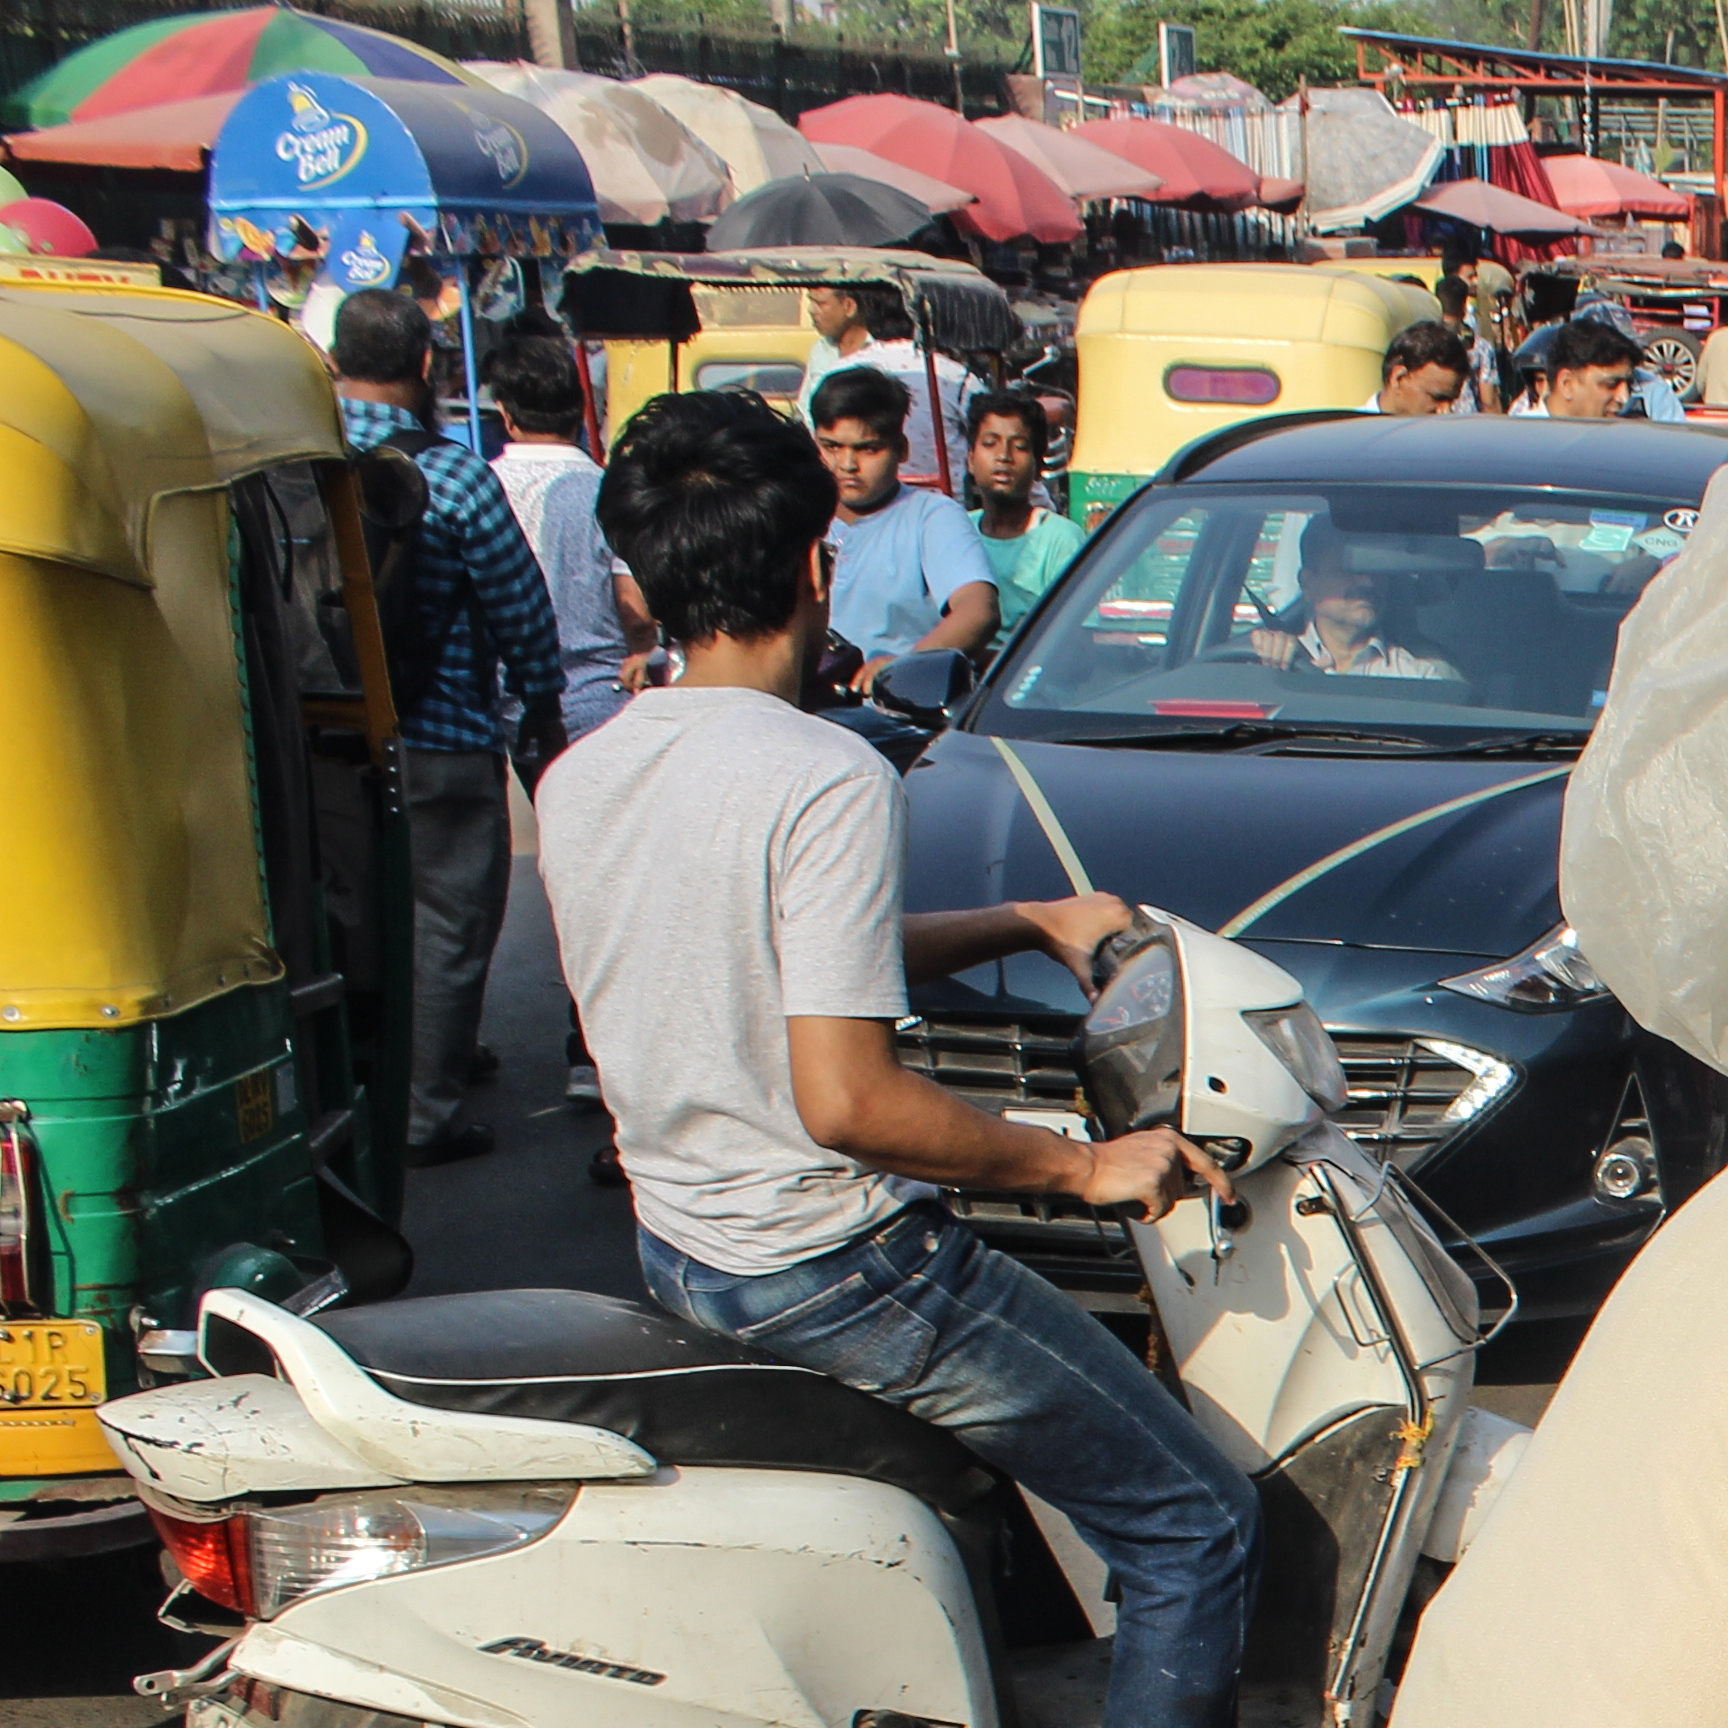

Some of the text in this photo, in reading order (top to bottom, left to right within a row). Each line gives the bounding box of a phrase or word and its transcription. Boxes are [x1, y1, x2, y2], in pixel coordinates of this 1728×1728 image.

[275, 123, 351, 162] Cream
[297, 147, 341, 182] Bell
[1644, 537, 1679, 548] CNG
